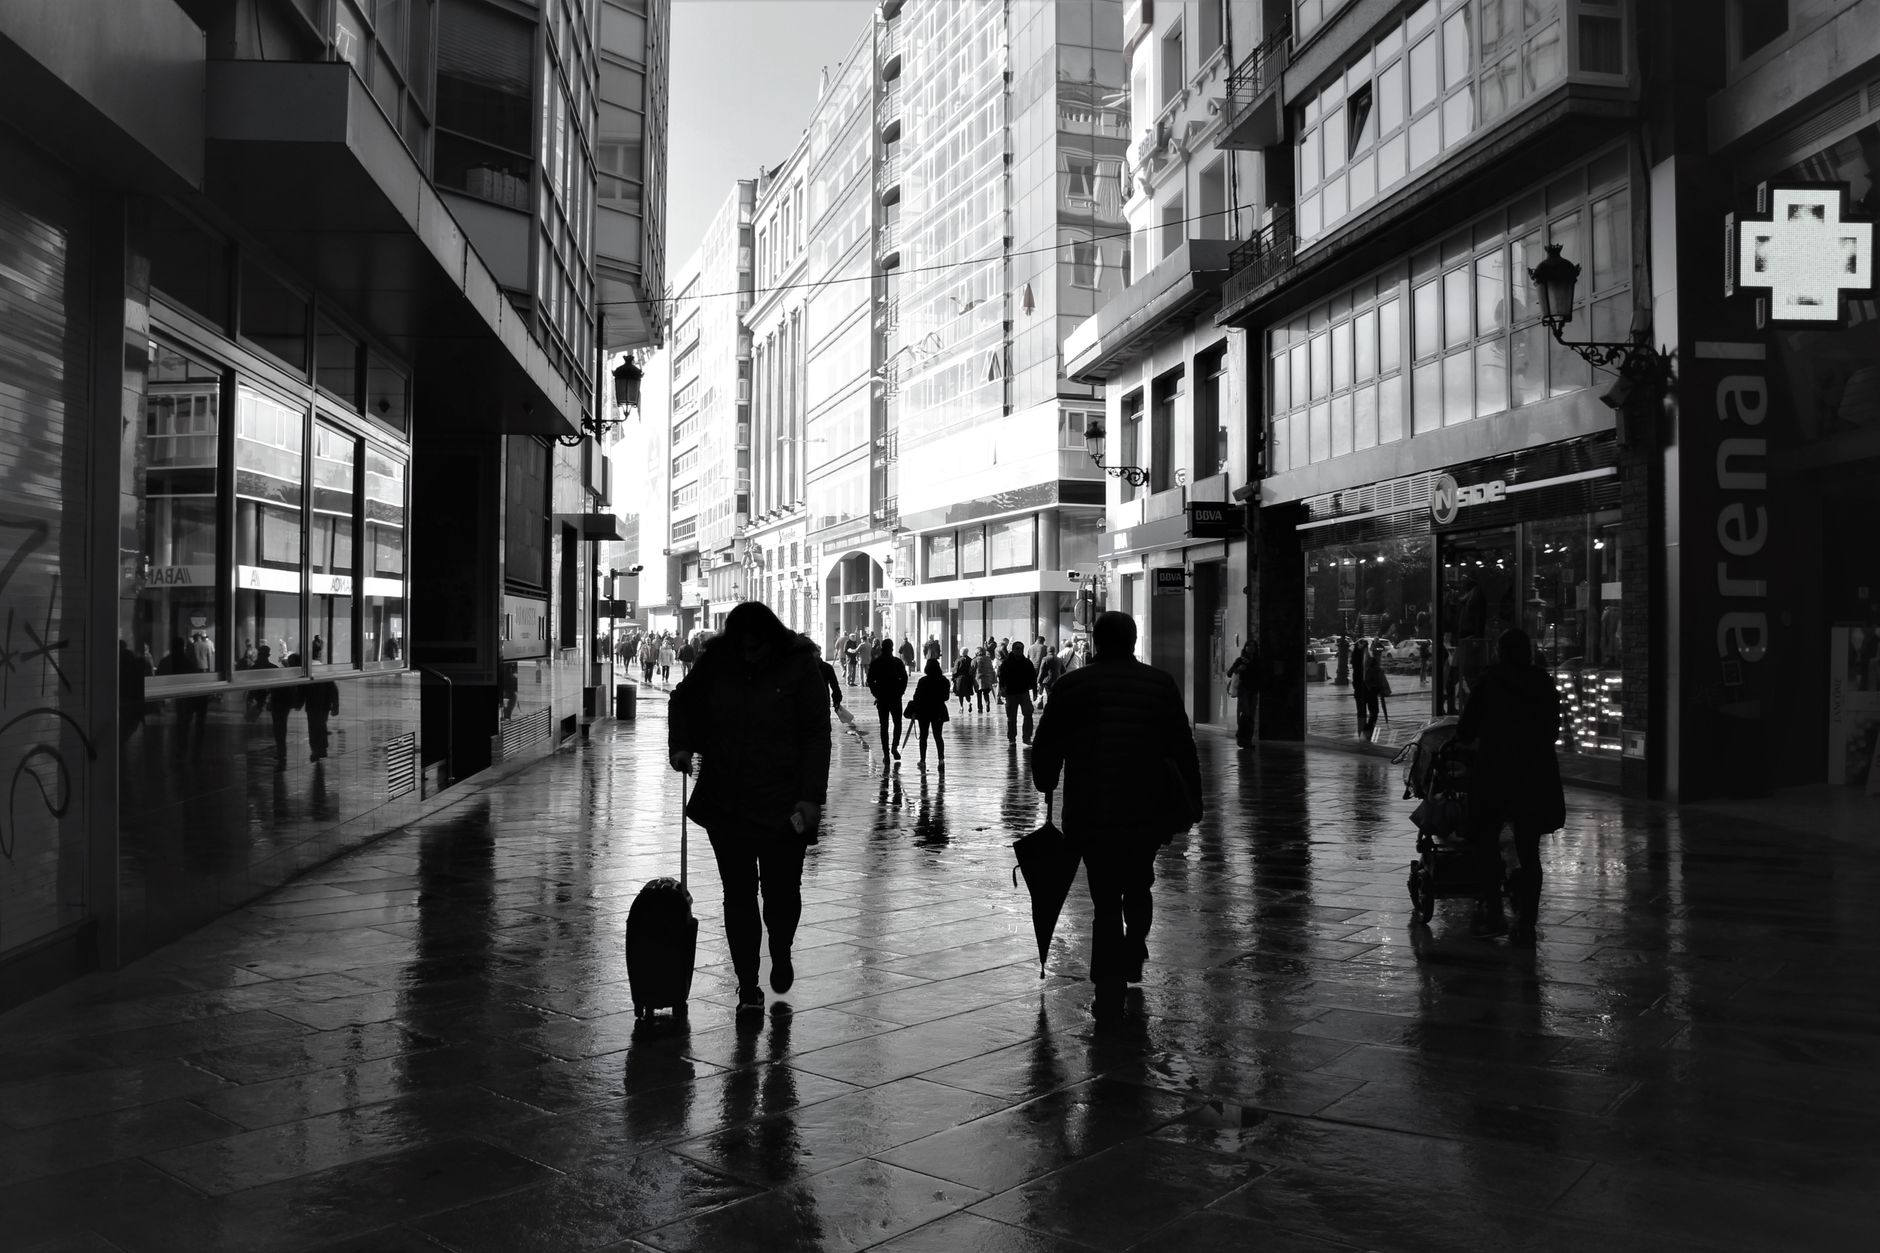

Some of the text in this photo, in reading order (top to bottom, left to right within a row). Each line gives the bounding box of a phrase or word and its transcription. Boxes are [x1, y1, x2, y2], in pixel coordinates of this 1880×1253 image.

[1695, 341, 1768, 662] arenal
[1195, 510, 1223, 521] BBVA
[1159, 572, 1182, 582] BBVA
